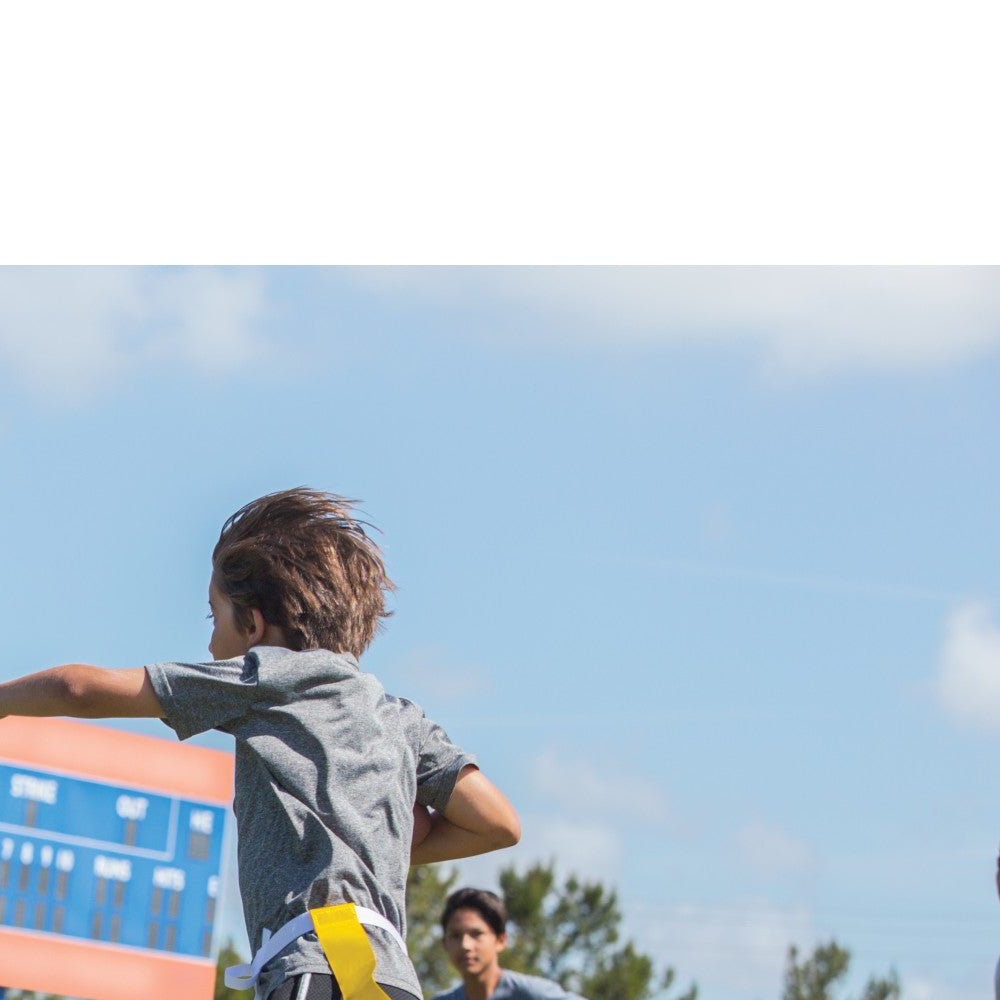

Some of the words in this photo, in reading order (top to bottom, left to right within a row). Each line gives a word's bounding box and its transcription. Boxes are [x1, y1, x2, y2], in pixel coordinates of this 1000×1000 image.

[11, 774, 57, 804] STRIKE
[116, 795, 148, 820] OUT
[1, 838, 14, 861] 7
[20, 842, 34, 864] 8
[40, 845, 53, 868] 9
[56, 849, 75, 872] 10
